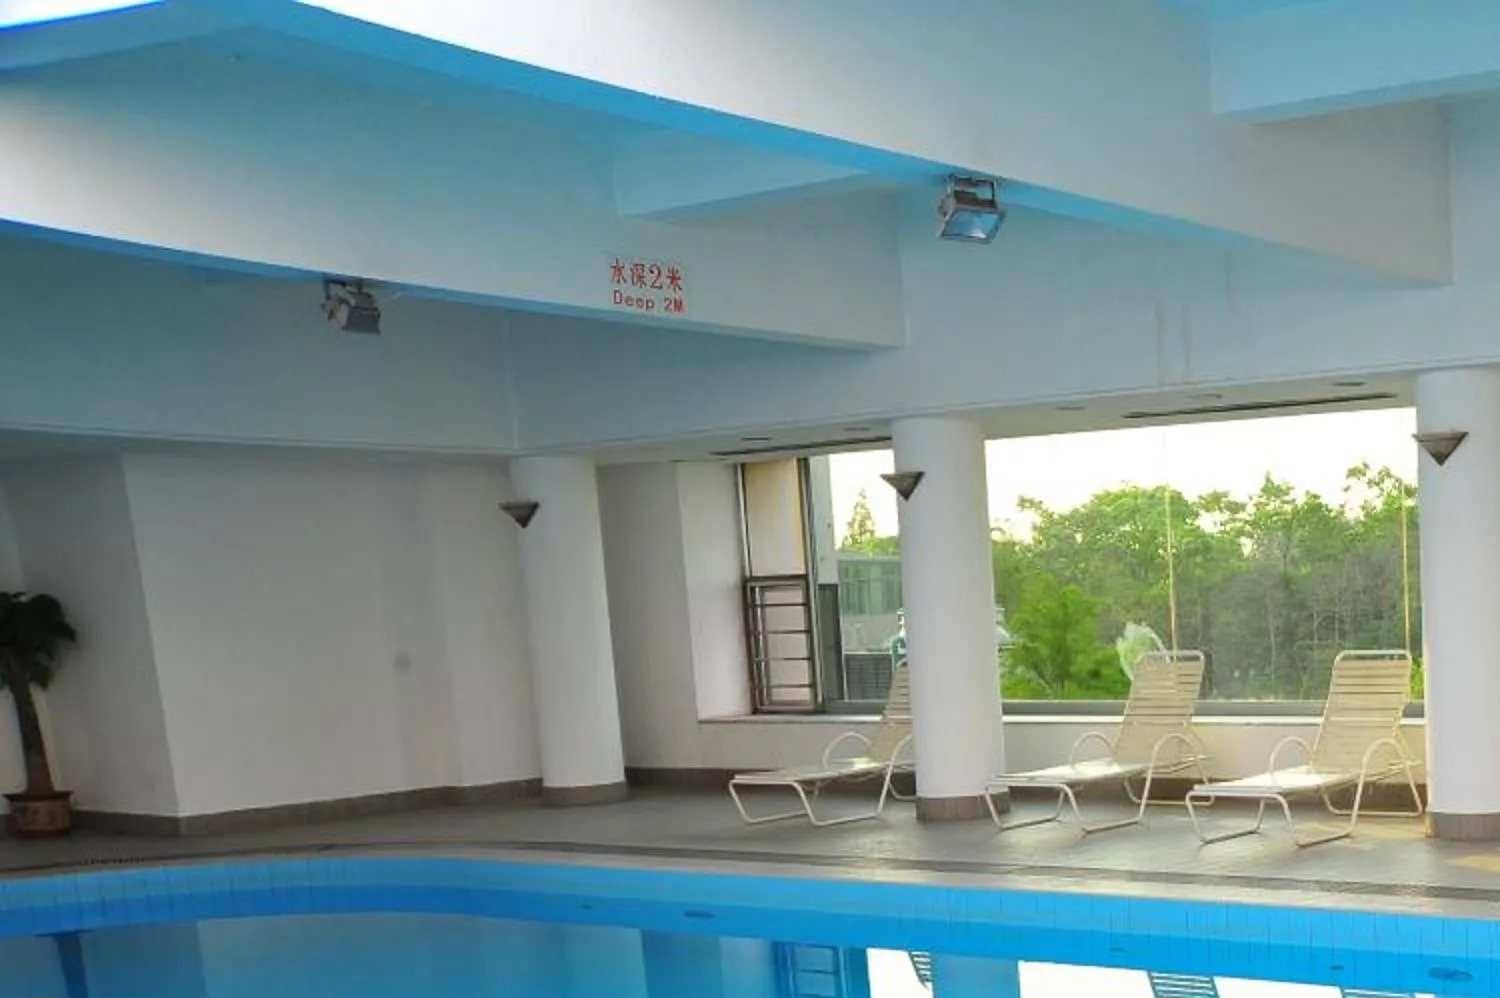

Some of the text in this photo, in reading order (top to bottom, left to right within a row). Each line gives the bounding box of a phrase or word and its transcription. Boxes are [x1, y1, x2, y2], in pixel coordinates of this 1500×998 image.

[610, 257, 683, 293] 水深2米
[613, 289, 685, 313] Deep 2M
